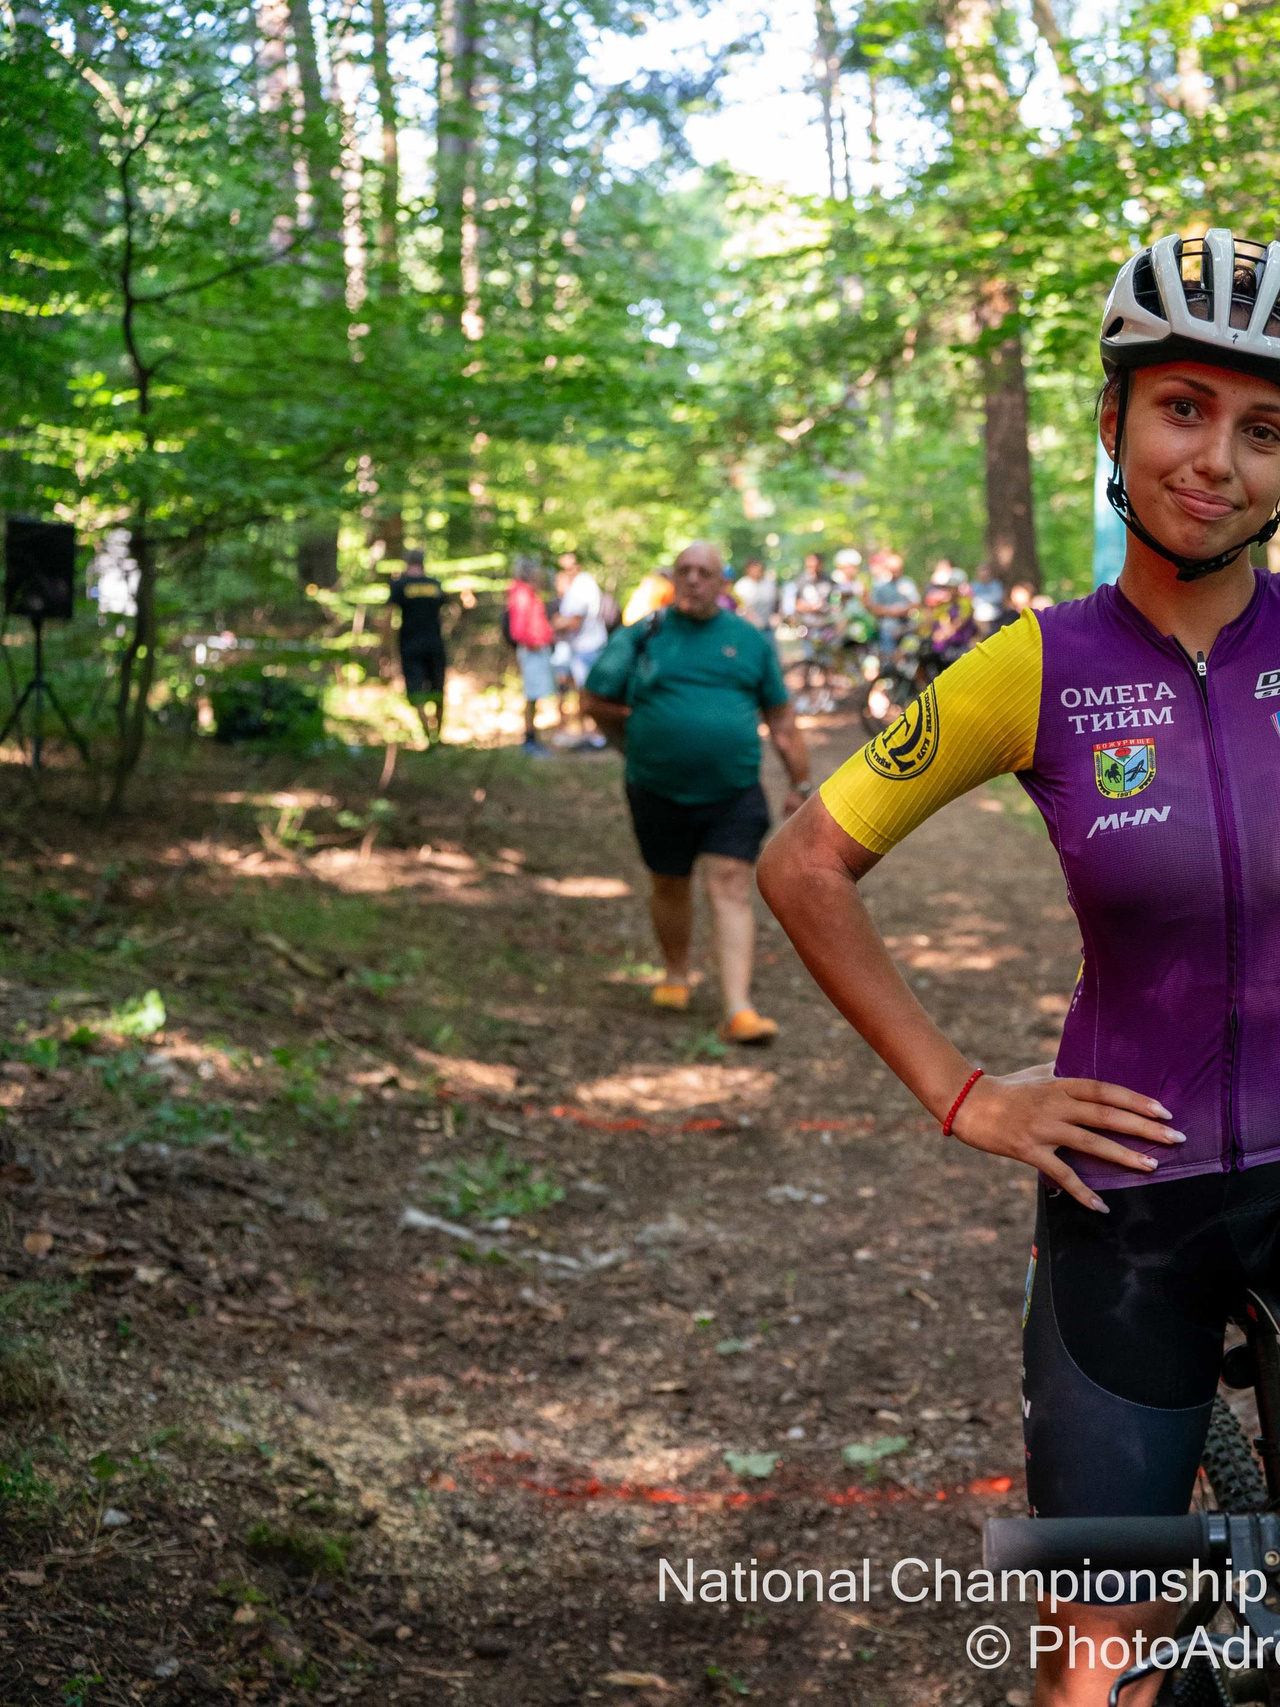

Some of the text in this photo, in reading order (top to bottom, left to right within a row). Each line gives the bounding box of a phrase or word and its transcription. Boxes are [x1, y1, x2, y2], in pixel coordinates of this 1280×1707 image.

[1060, 681, 1177, 709] ОМЕГА
[1068, 705, 1175, 735] ТИЙМ
[1096, 738, 1152, 750] БОЖУРИЩЕ
[1086, 806, 1172, 839] MHN
